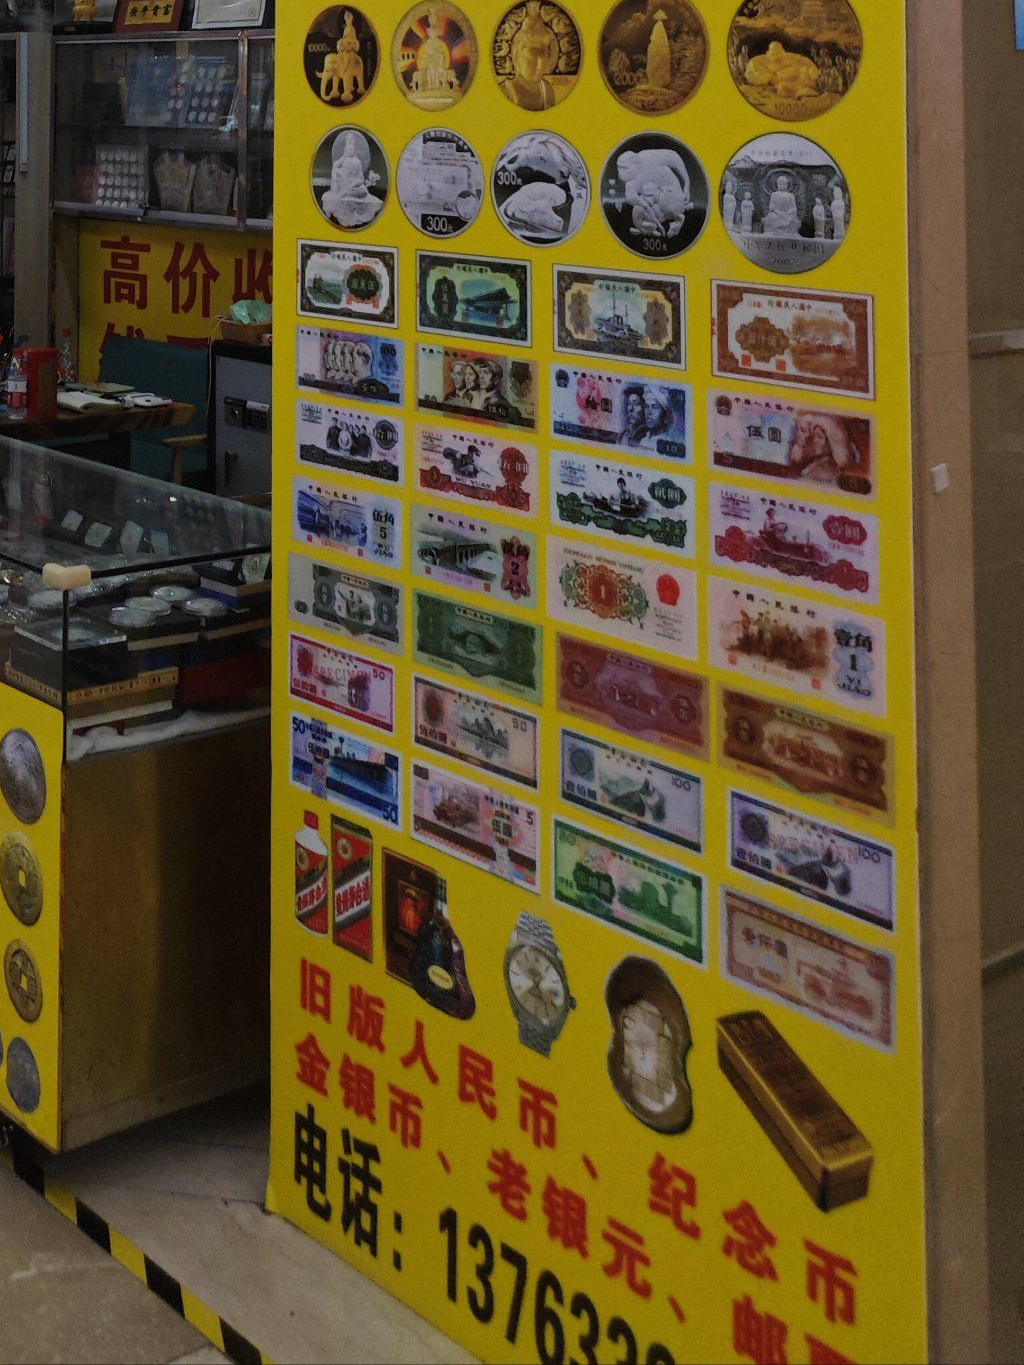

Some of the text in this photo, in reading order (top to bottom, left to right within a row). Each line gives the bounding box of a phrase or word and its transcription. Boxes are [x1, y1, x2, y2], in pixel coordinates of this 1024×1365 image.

[292, 715, 307, 734] 50
[382, 804, 398, 825] 50
[293, 1102, 678, 1365] 电话： 13763
